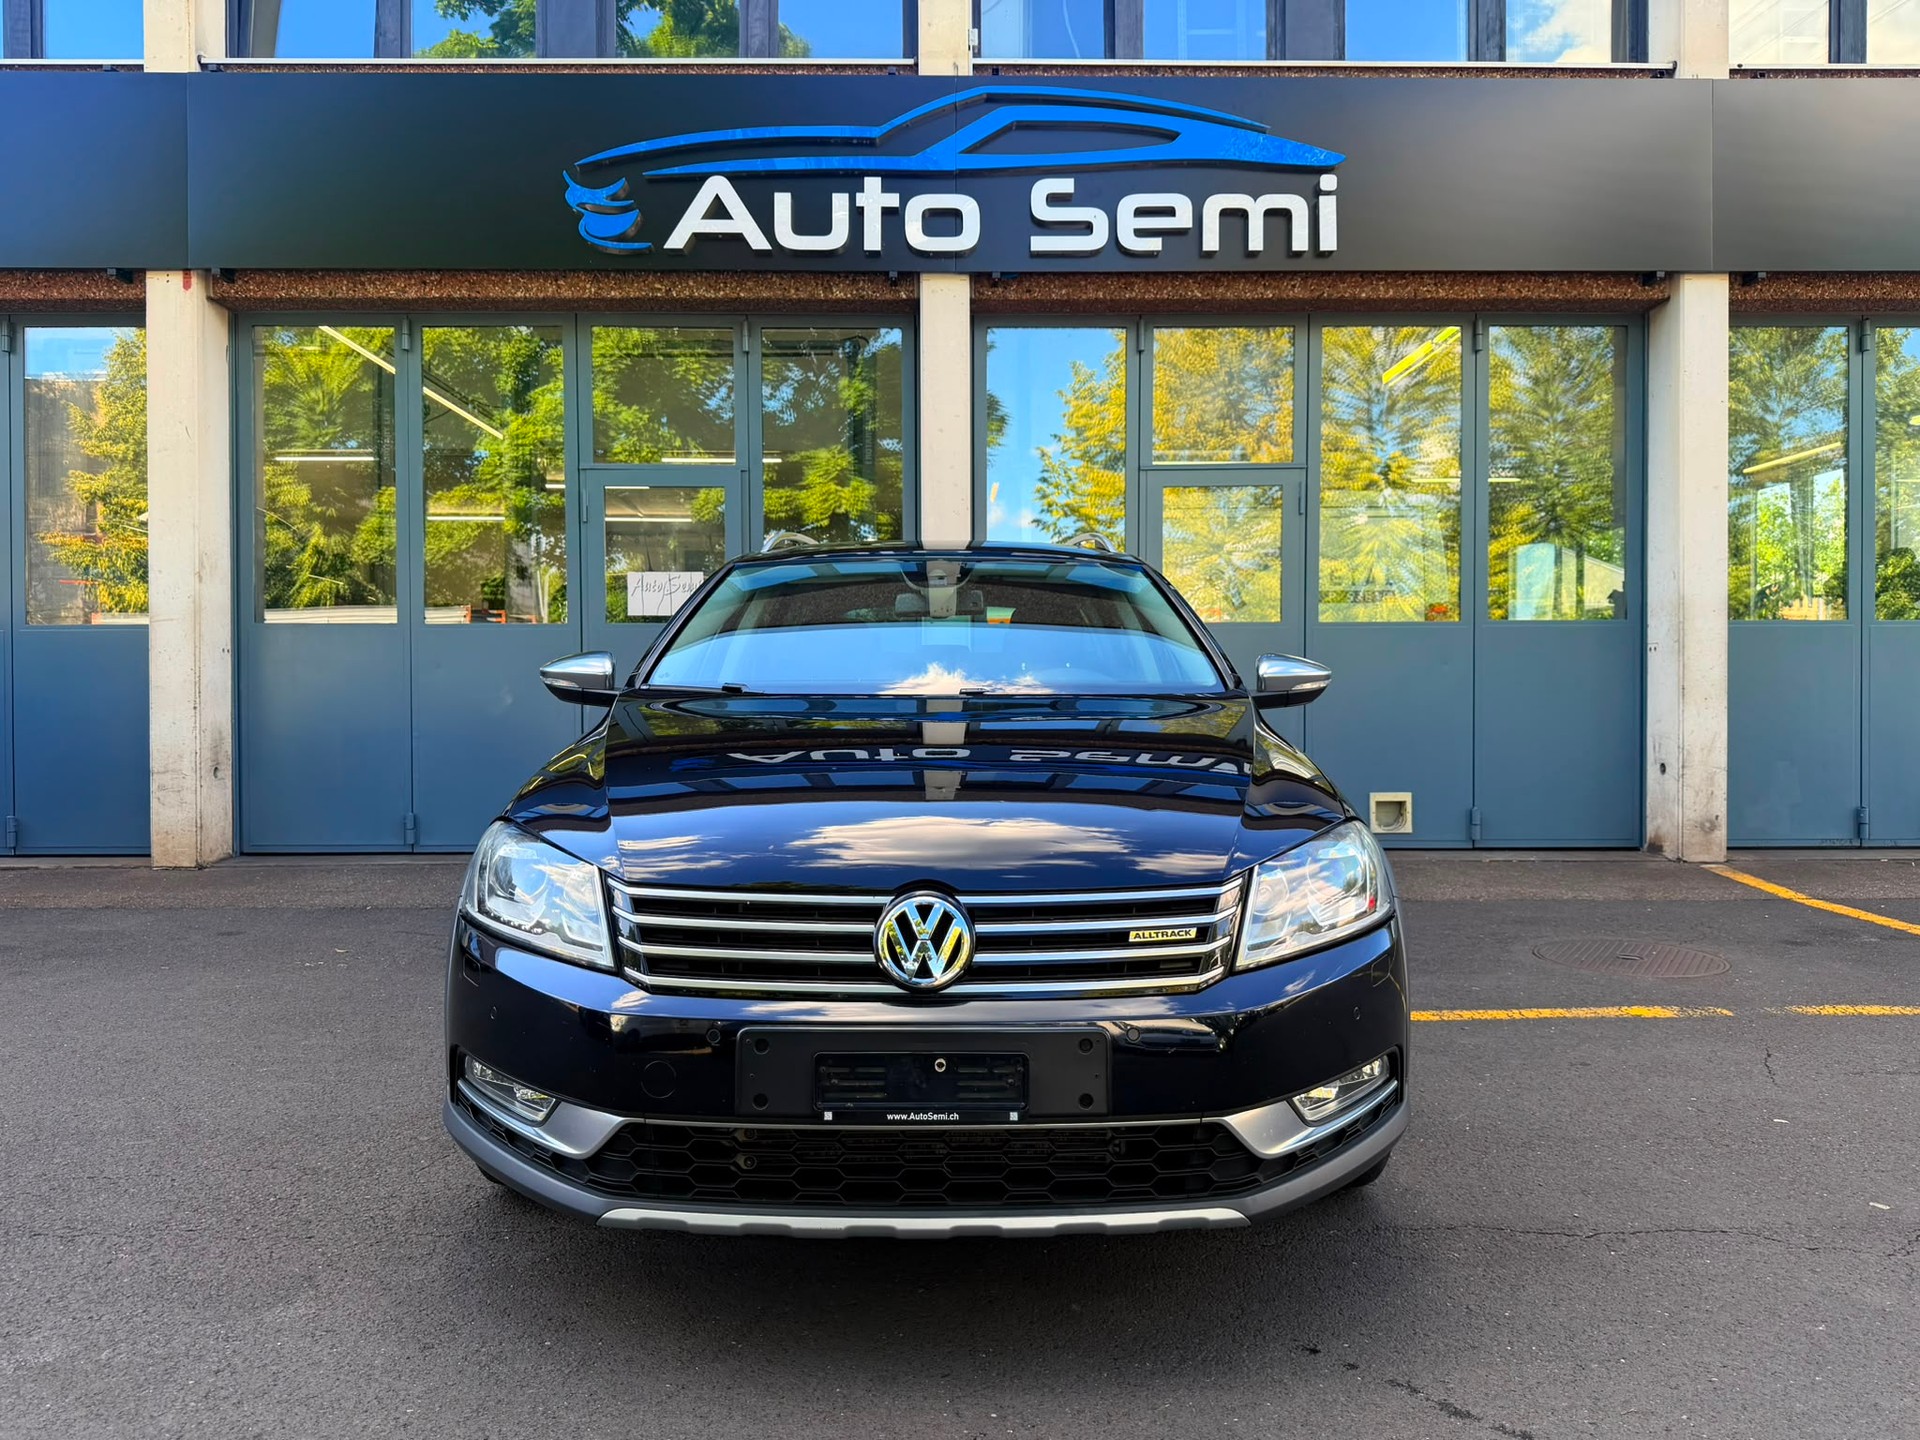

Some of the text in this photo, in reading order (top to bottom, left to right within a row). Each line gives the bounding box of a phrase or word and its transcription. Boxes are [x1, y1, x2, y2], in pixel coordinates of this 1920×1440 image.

[663, 173, 1338, 254] Auto Semi
[1133, 929, 1192, 940] ALLTRACK
[886, 1111, 960, 1121] www.AutoSemi.ch
